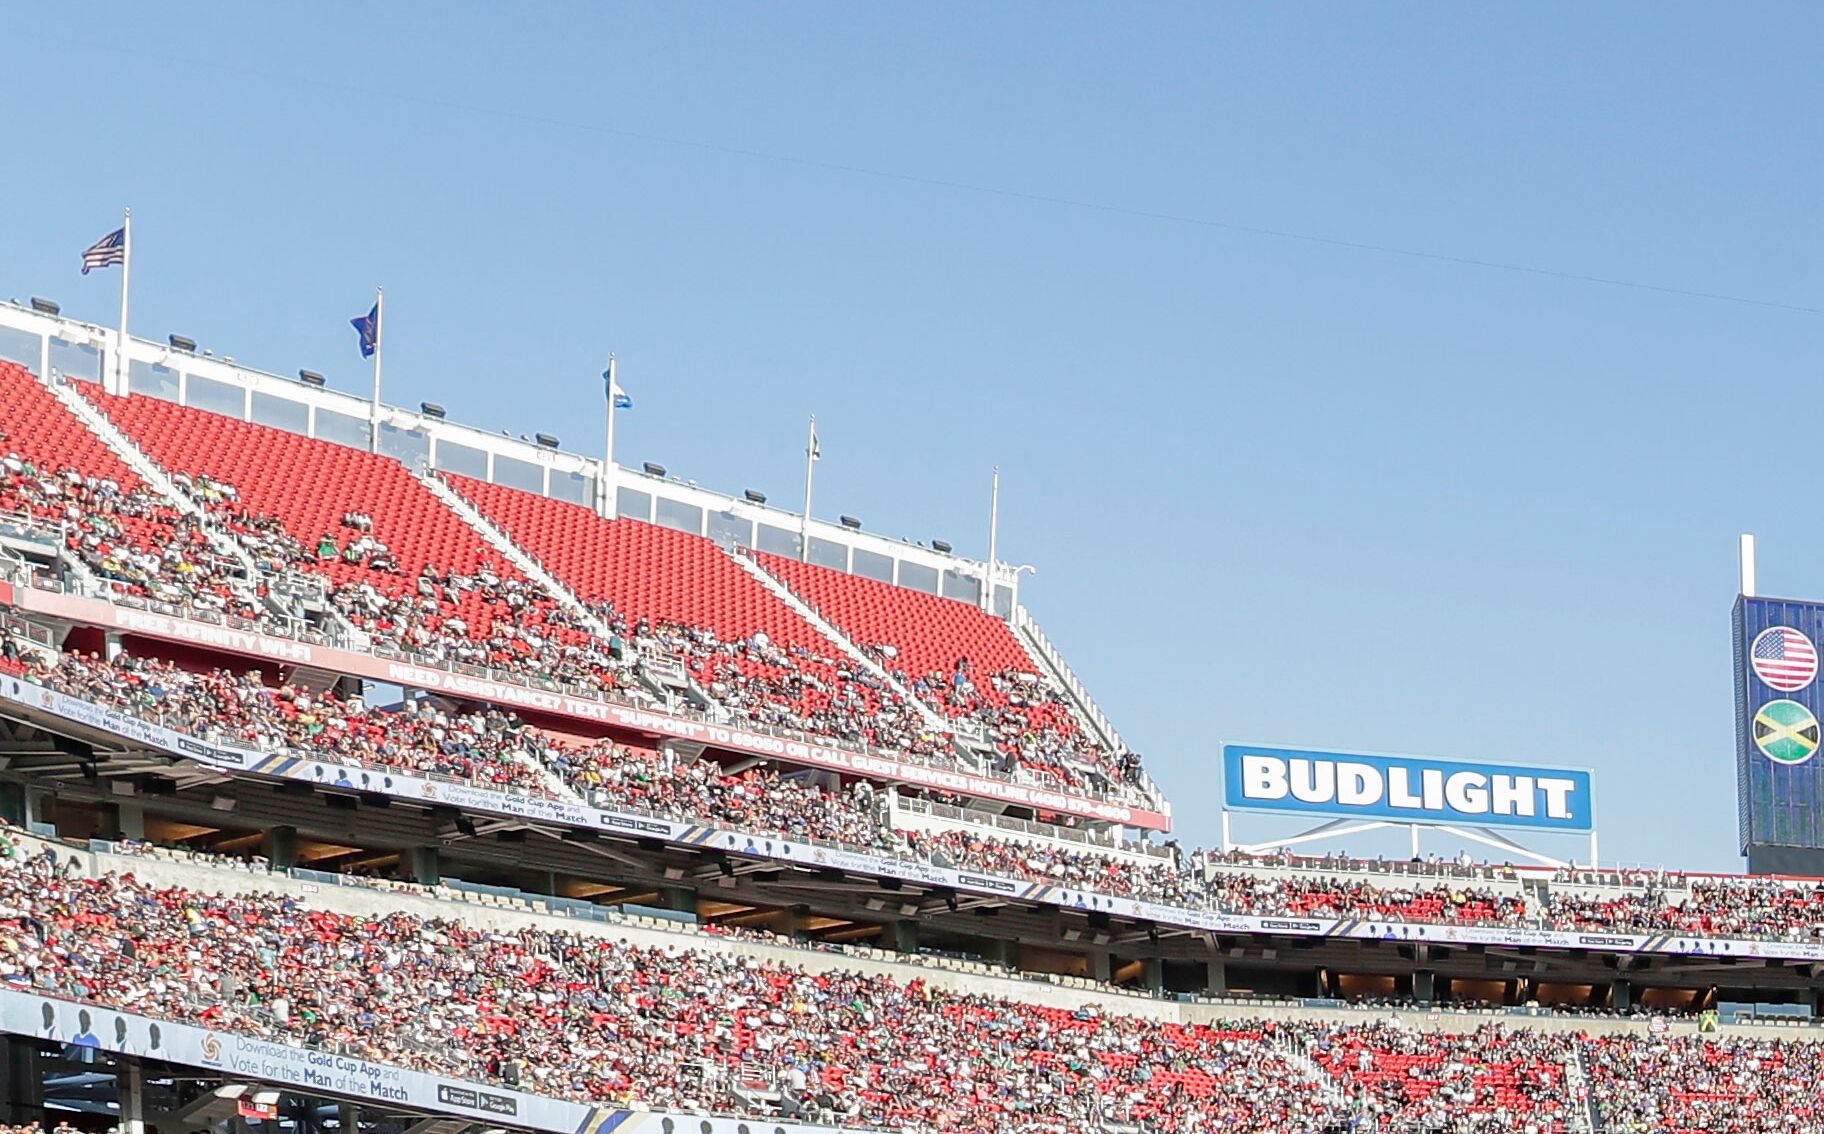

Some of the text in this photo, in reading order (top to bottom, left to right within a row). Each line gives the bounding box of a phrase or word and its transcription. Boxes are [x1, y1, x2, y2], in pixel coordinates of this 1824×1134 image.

[115, 611, 312, 662] FREE XFINITY WI-FI
[388, 664, 441, 686] NEED
[443, 673, 563, 712] ASSISTANCE?
[565, 698, 609, 718] TEXT
[707, 726, 730, 743] TO
[786, 741, 809, 757] OR
[810, 745, 851, 767] CALL
[851, 756, 899, 776] GUEST
[900, 765, 969, 790] SERVICES
[970, 777, 1027, 803] HOTLINE
[1242, 754, 1576, 819] BUD LIGHT
[229, 1055, 409, 1102] Vote for the Man of the Match
[236, 1035, 400, 1081] Download the Gold Cup App and
